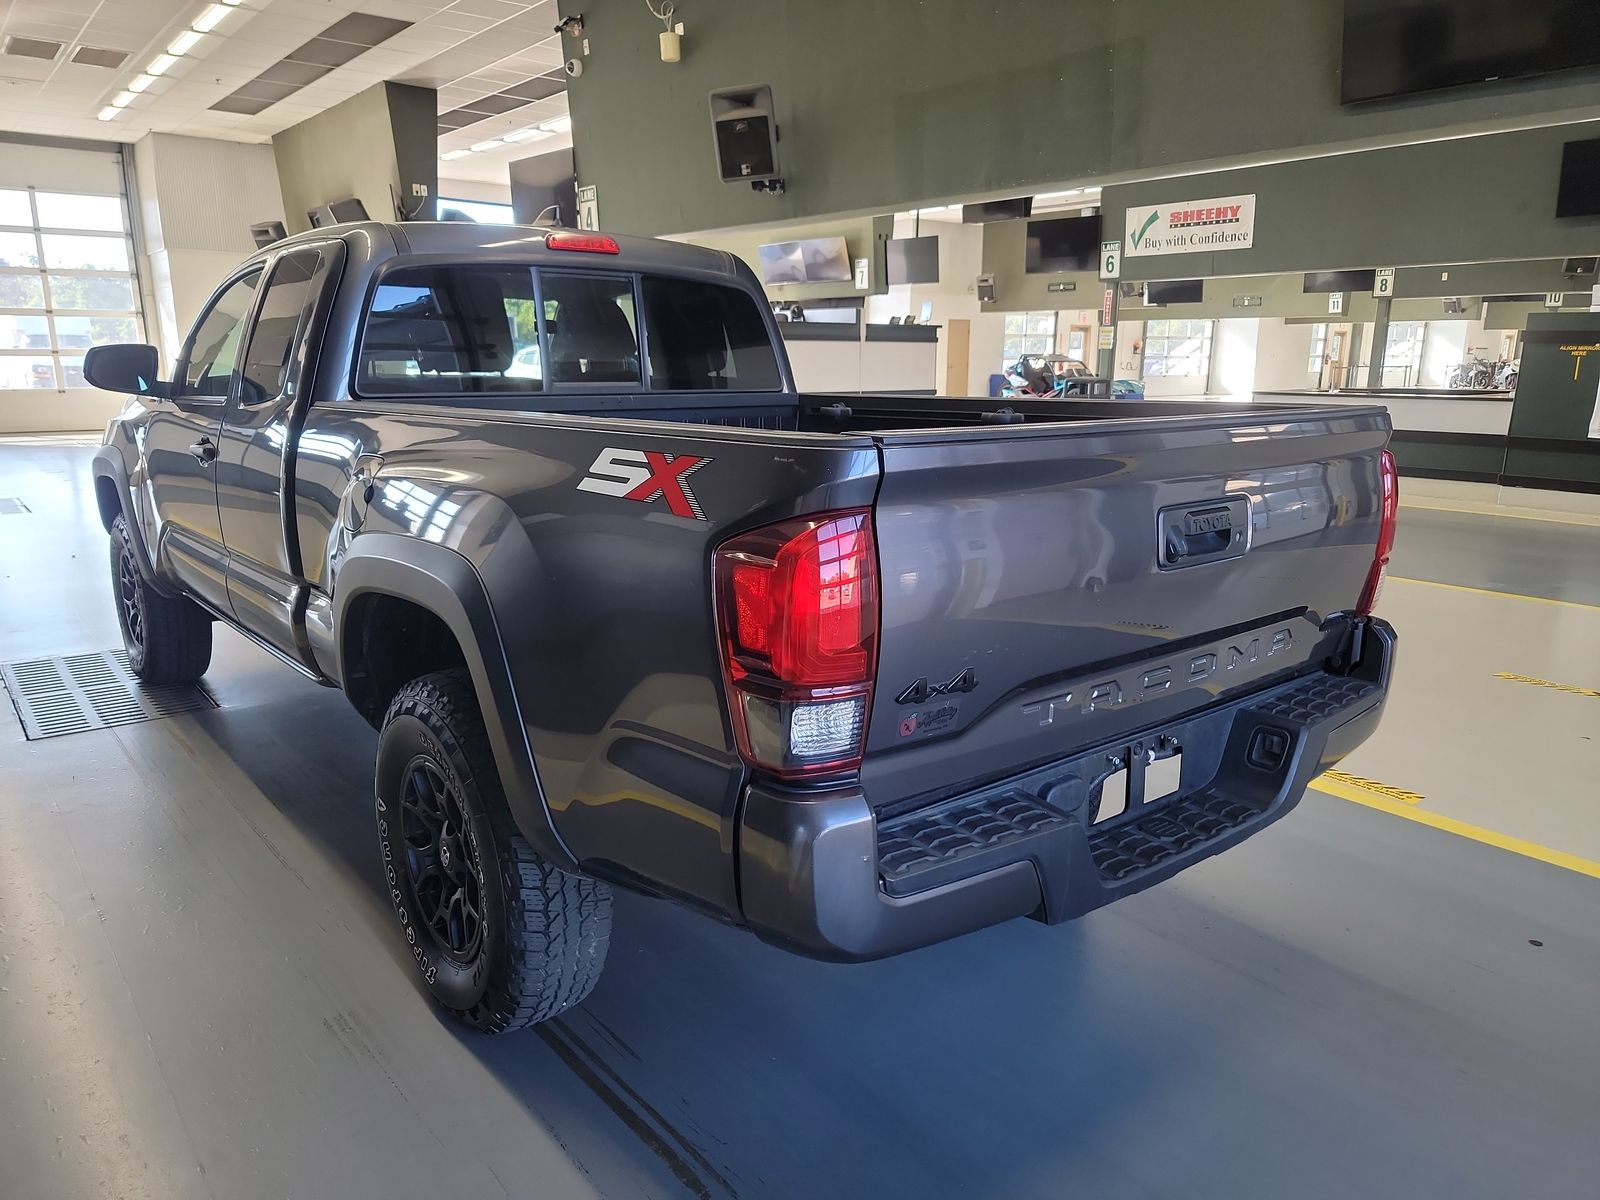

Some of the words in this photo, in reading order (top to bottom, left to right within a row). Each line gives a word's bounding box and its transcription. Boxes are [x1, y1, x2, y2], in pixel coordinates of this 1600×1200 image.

[586, 206, 594, 230] 4
[1169, 205, 1242, 223] SHEEHY
[1102, 243, 1120, 252] LANE
[1144, 237, 1163, 249] Buy
[1165, 234, 1187, 247] with
[1189, 231, 1249, 246] Confidence
[1105, 254, 1115, 273] 6
[859, 270, 864, 285] 7
[1379, 278, 1388, 292] 8
[1332, 300, 1339, 310] 11
[576, 447, 715, 521] SX
[1192, 513, 1232, 533] TOYOTA
[1020, 628, 1294, 726] TACOMA
